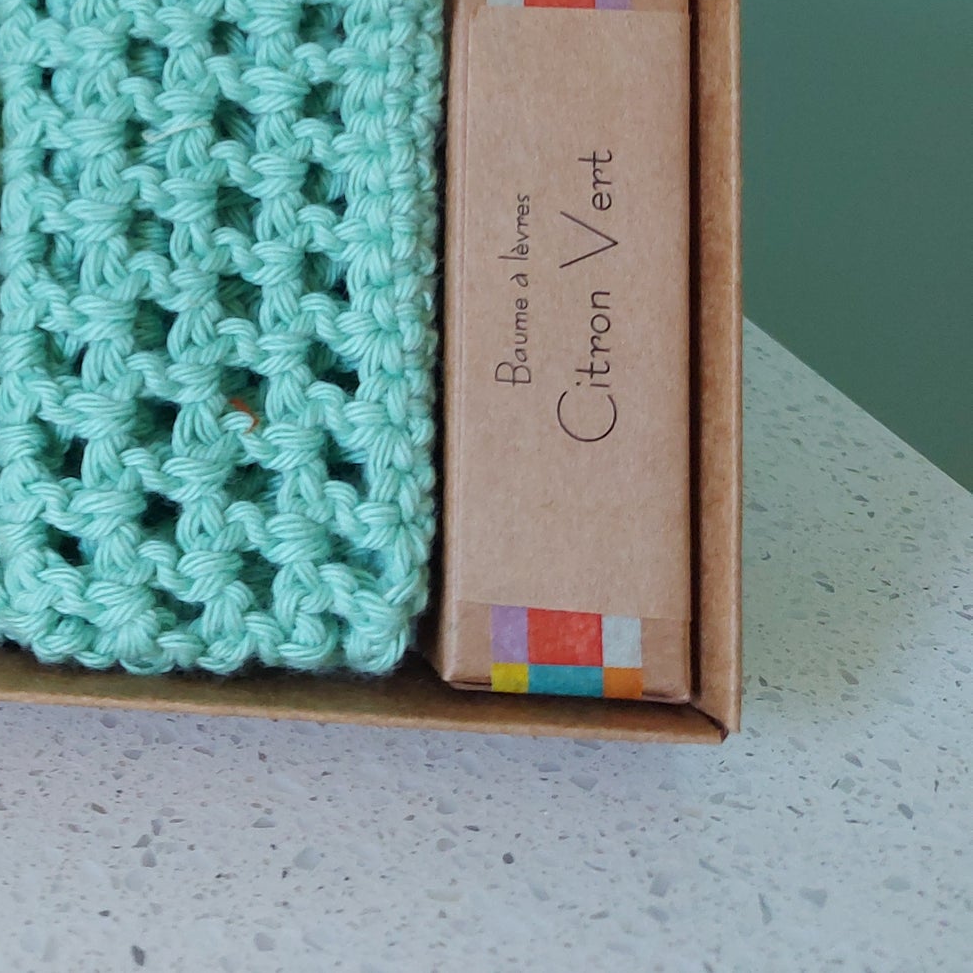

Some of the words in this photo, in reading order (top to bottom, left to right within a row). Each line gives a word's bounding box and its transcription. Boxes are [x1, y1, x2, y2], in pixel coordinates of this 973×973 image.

[498, 193, 530, 261] lèvres
[559, 149, 619, 269] Vert
[510, 273, 529, 288] à
[494, 297, 531, 386] Baume
[557, 289, 617, 443] Citron
